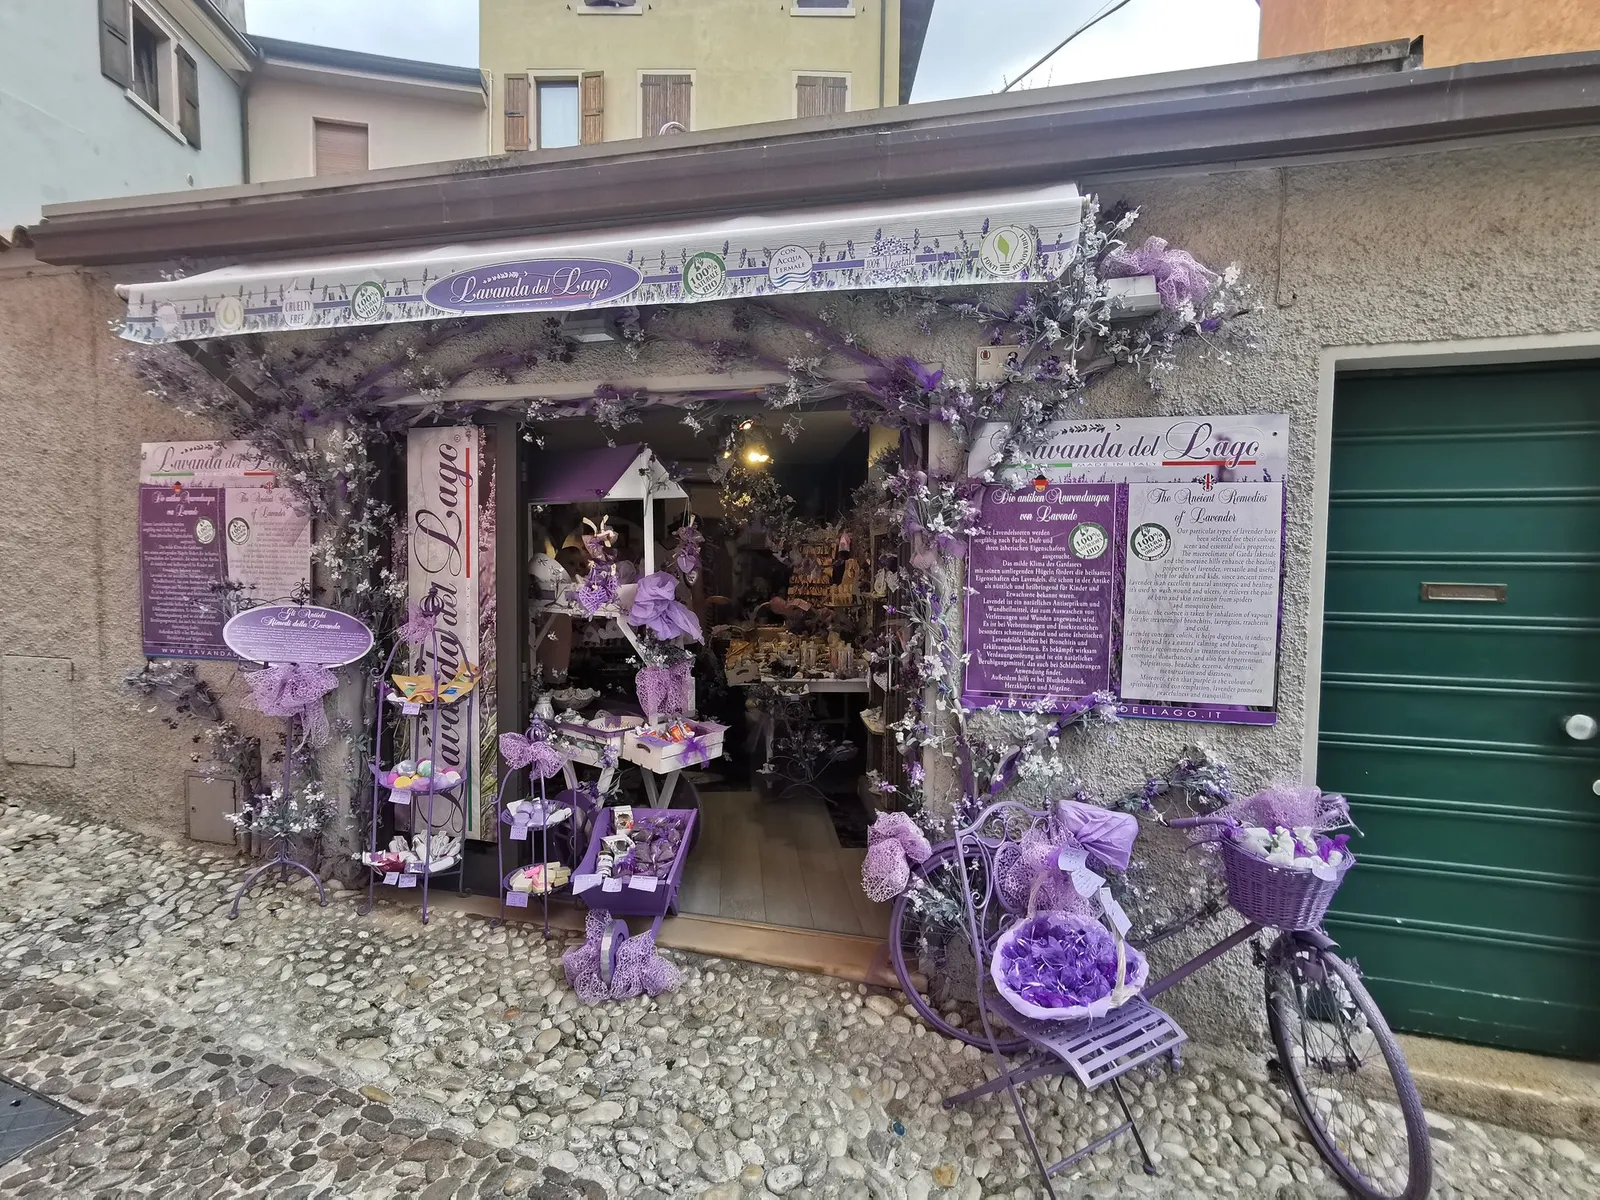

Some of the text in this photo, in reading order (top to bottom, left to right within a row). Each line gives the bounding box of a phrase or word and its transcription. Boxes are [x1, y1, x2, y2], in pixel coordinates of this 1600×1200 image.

[780, 248, 796, 256] CON
[773, 262, 805, 274] TERMALE
[777, 255, 803, 266] ACQUA
[866, 255, 915, 270] 100% Vegetale
[984, 257, 998, 272] FONTI
[690, 263, 718, 285] 100%
[694, 270, 719, 290] NATURALE
[450, 267, 611, 303] Lavanda del Lago
[702, 280, 718, 293] BIO
[357, 292, 379, 309] 100%
[290, 314, 304, 324] FREE
[365, 306, 378, 317] BIO
[992, 421, 1260, 468] avanda del Lago
[152, 446, 221, 472] Lavanda
[225, 456, 242, 469] del
[991, 487, 1110, 507] Die antiken Anwendungen
[1147, 487, 1268, 505] The Ancient Remedies
[1019, 512, 1033, 521] von
[1174, 507, 1237, 527] of Lavender
[1076, 532, 1100, 547] 100%
[1137, 532, 1163, 548] 100%
[1086, 546, 1100, 555] BIO
[278, 607, 327, 620] Gli Antichi
[261, 615, 341, 630] Rimedi della Lavanda
[413, 443, 473, 833] Lavada del Lago
